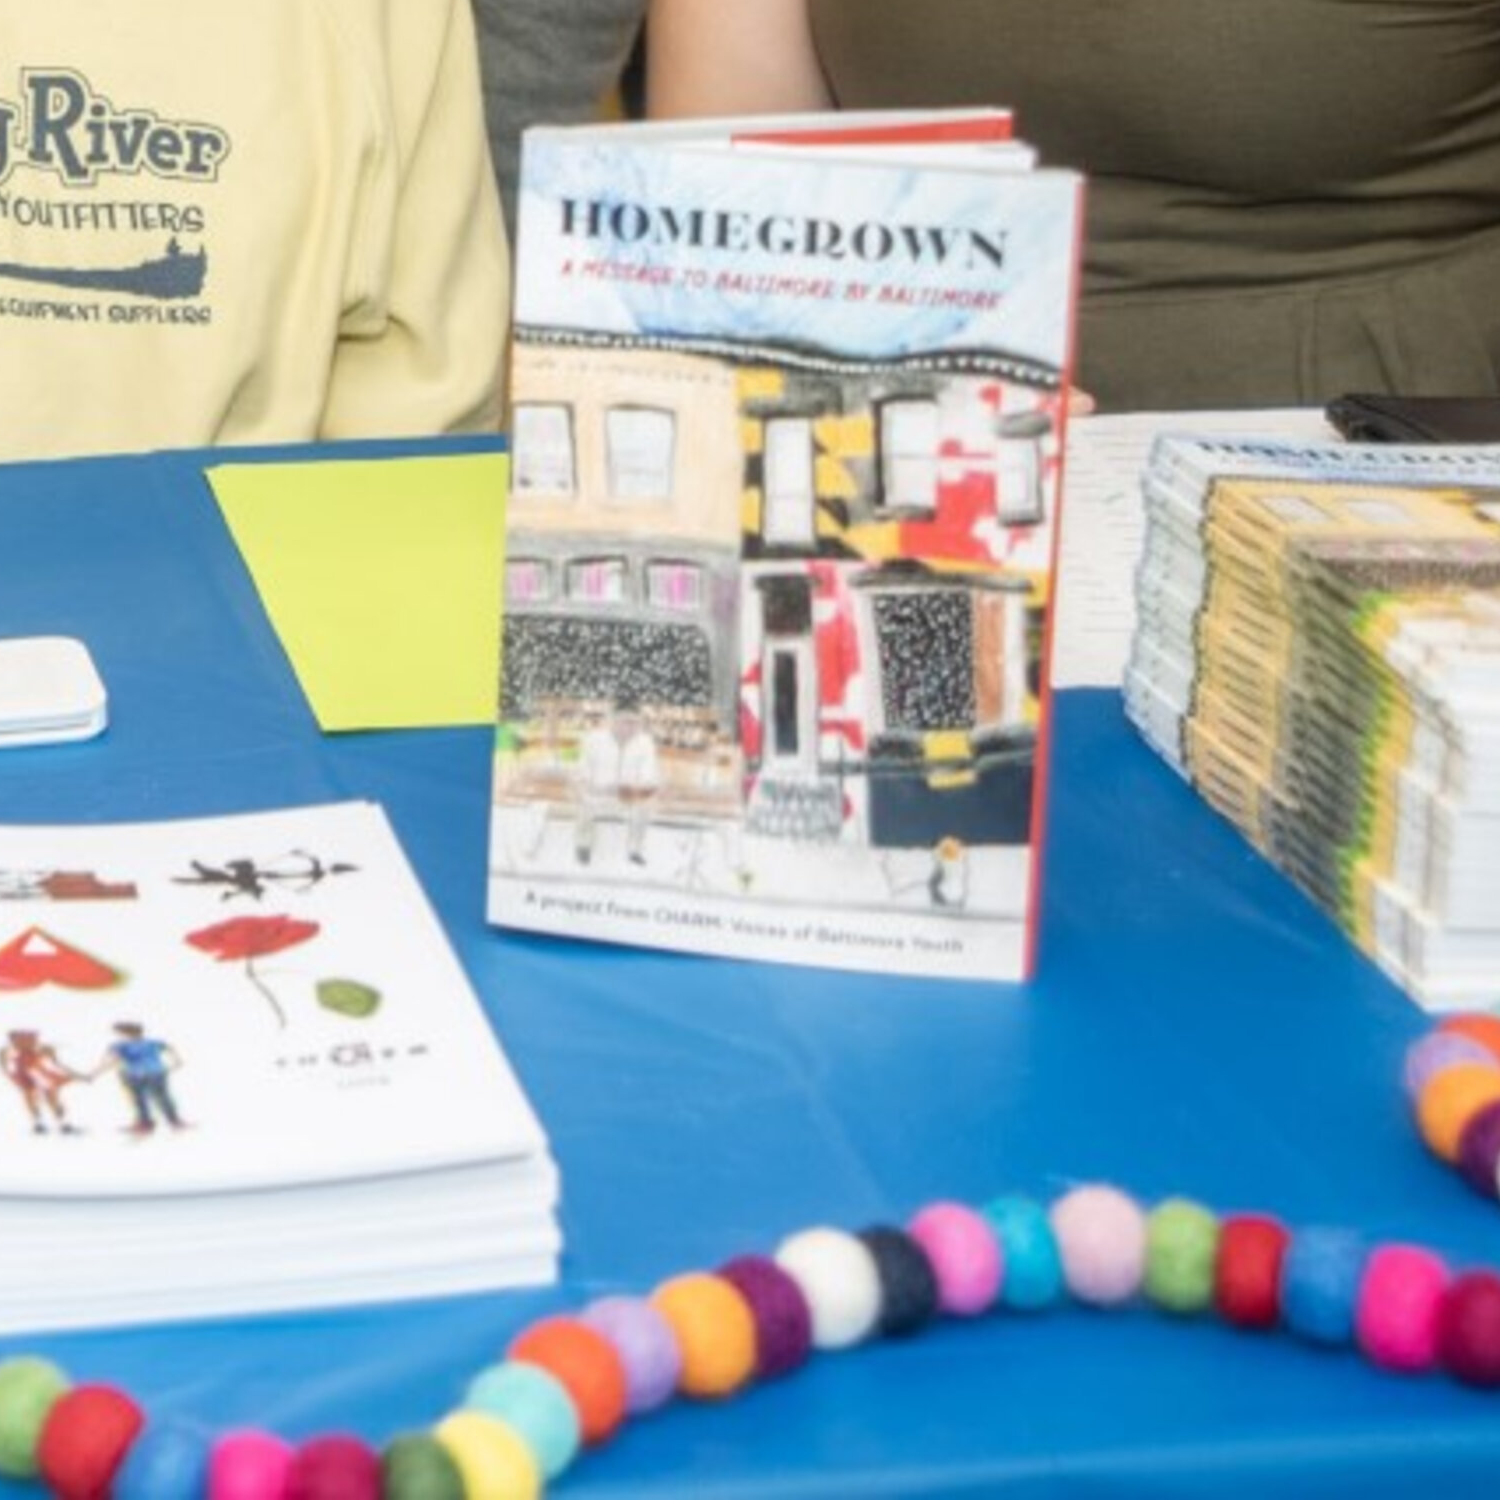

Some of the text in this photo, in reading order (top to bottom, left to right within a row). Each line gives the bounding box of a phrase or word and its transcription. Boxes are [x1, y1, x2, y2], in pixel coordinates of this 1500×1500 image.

[24, 71, 226, 182] River
[13, 197, 205, 233] OUTFITTERS
[560, 198, 1010, 269] HOMEGROWN
[581, 259, 674, 287] MESSAGE
[683, 268, 707, 289] TO
[715, 269, 833, 299] BALTIMORE
[877, 283, 1002, 310] BALTIMORE
[107, 303, 212, 326] SUPPLIERS
[606, 900, 650, 919] from
